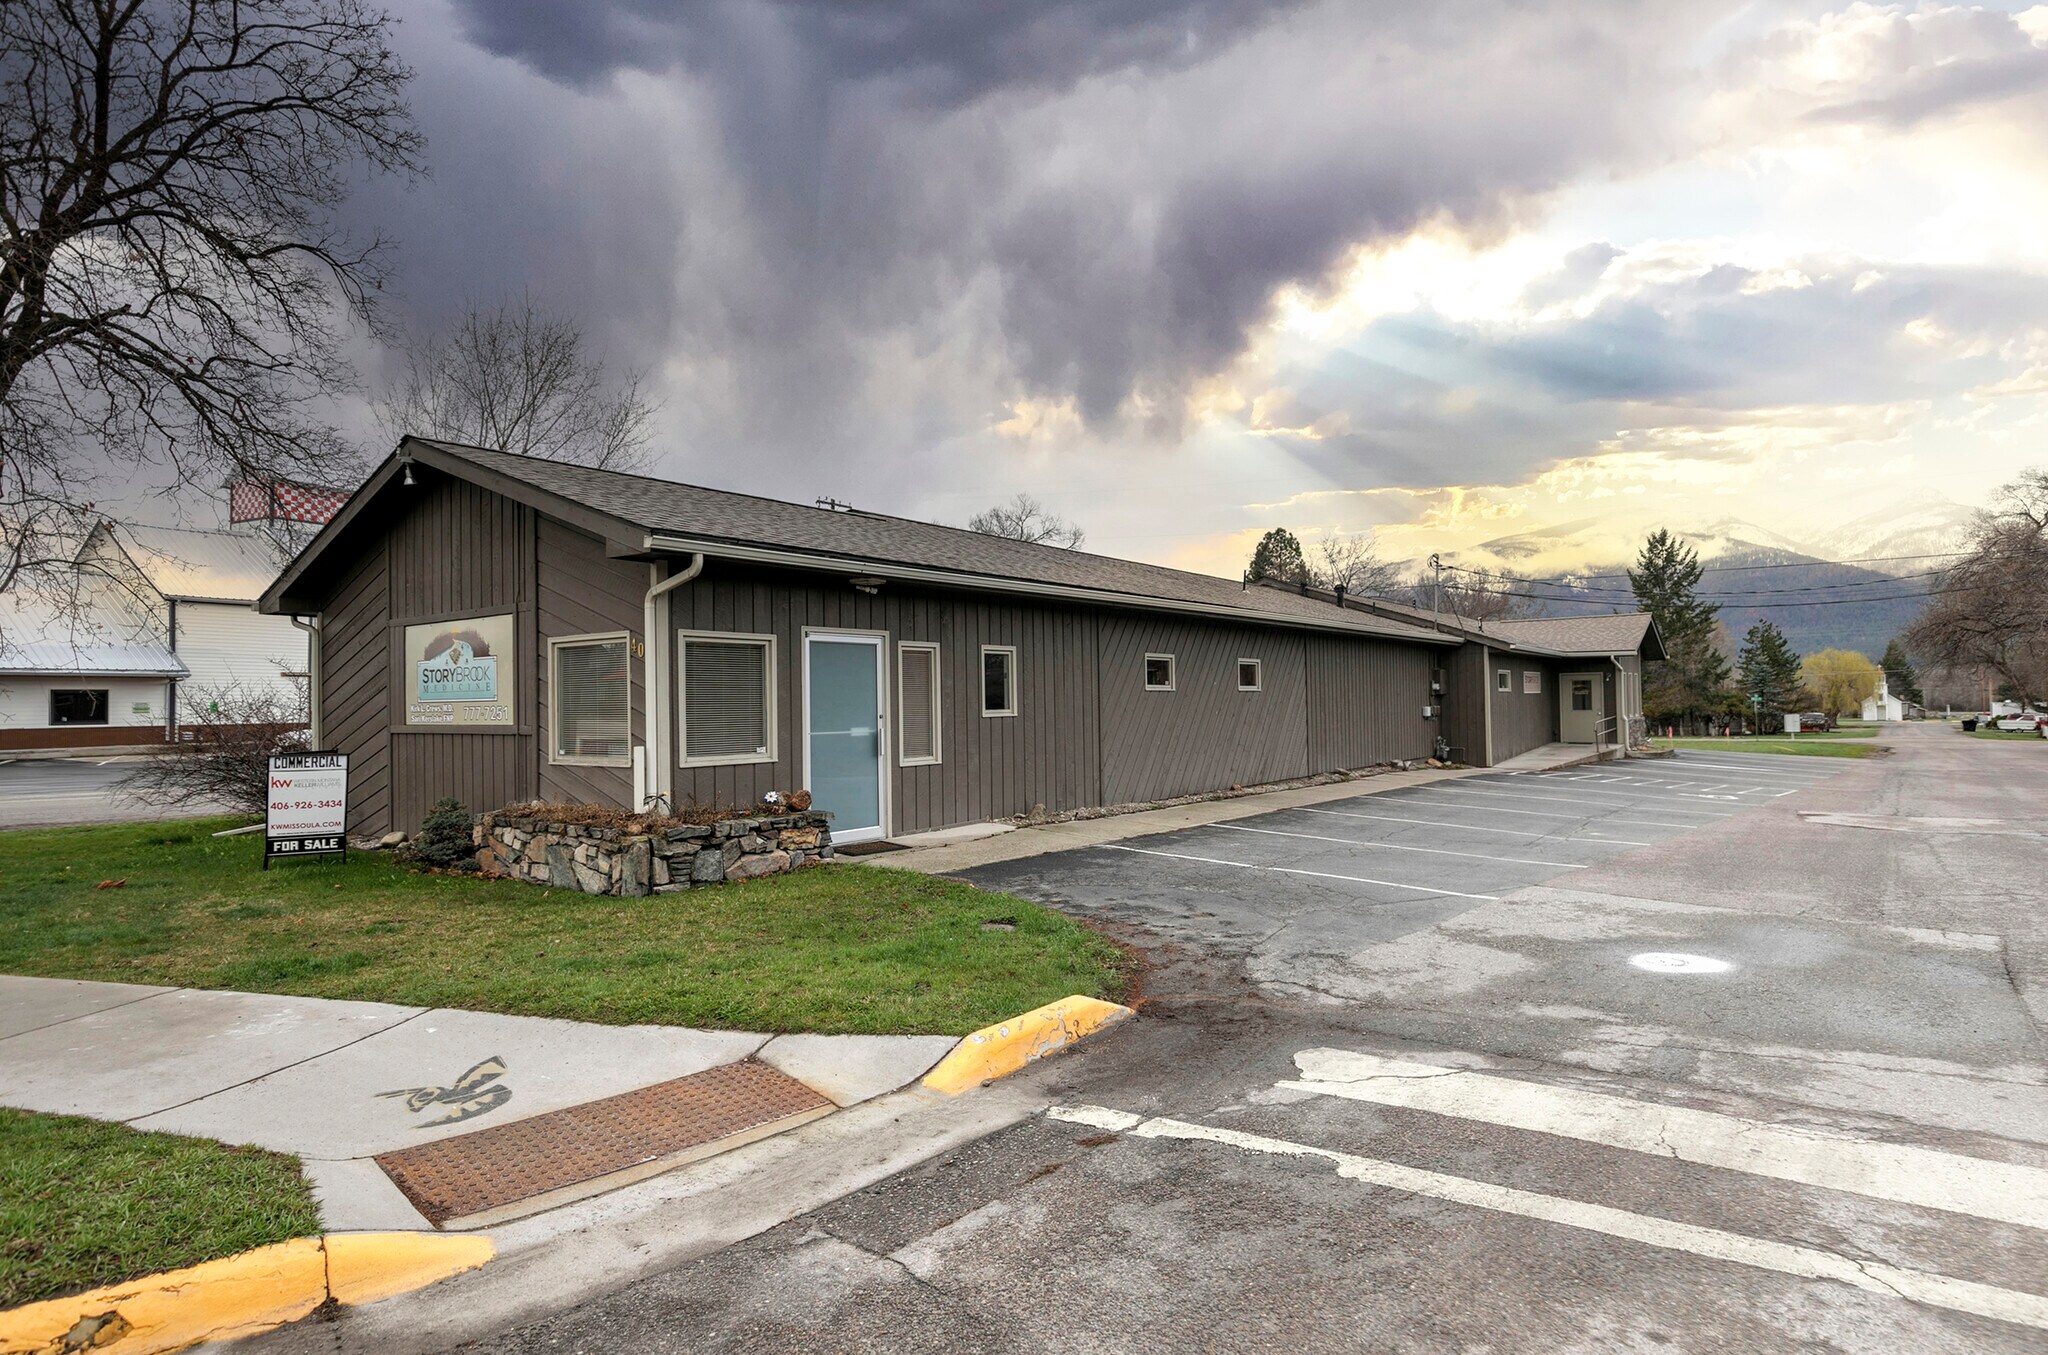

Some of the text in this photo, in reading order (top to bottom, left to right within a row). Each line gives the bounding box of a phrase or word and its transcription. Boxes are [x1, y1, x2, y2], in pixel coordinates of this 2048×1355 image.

[422, 666, 491, 684] STORYBROOK
[423, 682, 491, 693] MEDICINE
[463, 705, 508, 720] 777-7251
[274, 756, 342, 769] COMMERCIAL
[271, 776, 292, 788] kw
[271, 800, 342, 810] 406-926-3434
[271, 821, 342, 830] KWMISSOULA.COM
[273, 838, 339, 852] FOR SALE
